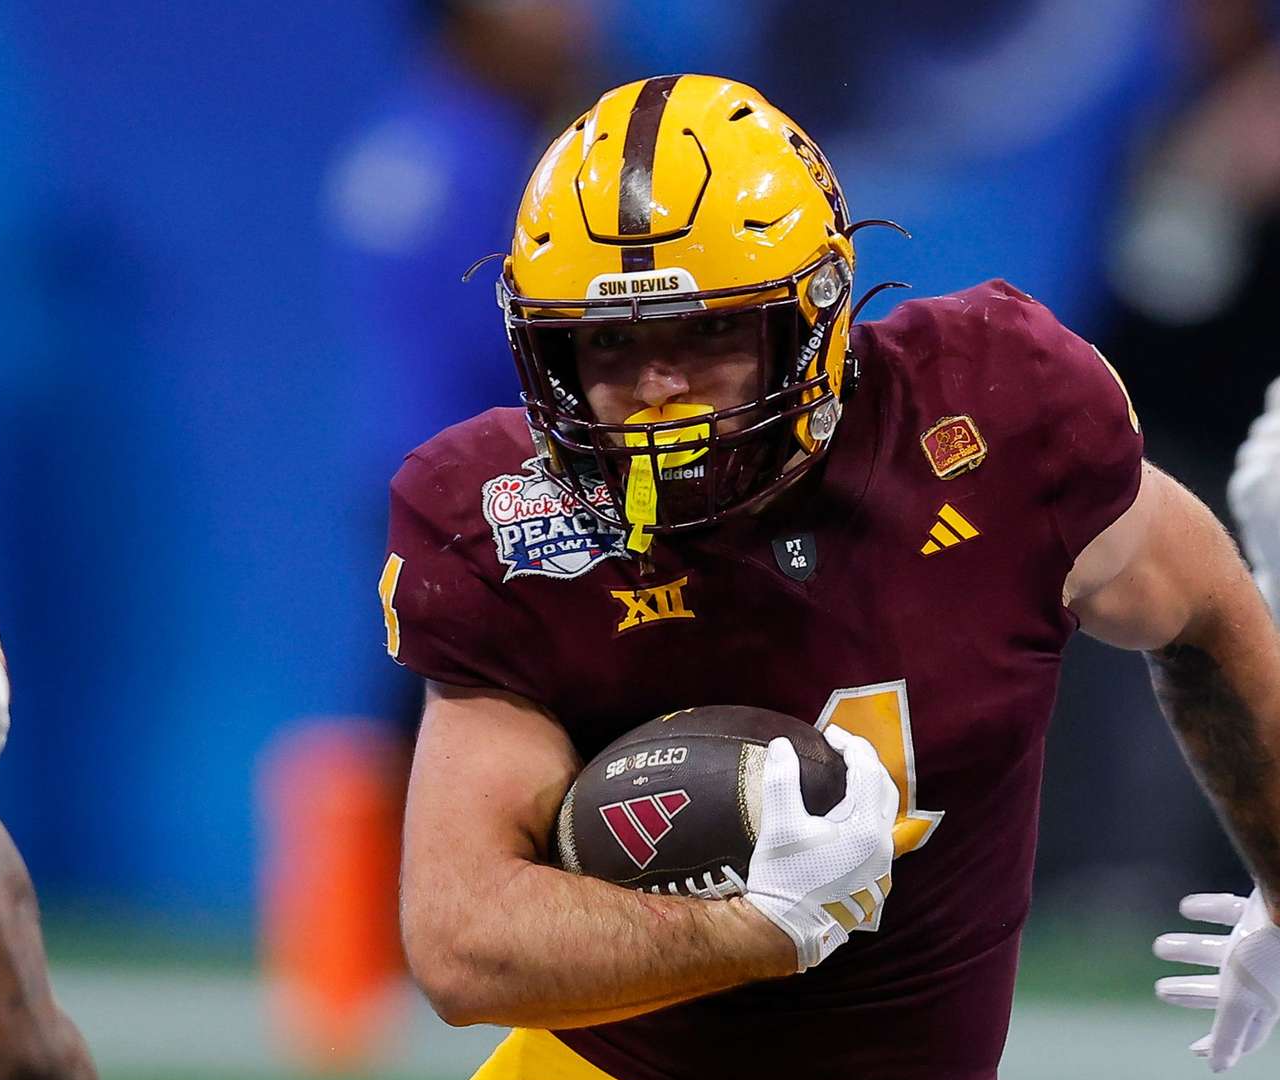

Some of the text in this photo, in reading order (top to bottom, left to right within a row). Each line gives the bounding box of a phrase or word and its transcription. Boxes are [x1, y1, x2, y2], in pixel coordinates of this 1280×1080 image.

[599, 276, 679, 296] SUN DEVILS
[528, 538, 600, 560] BOWL
[786, 539, 802, 553] PT
[790, 555, 807, 569] 42
[610, 576, 695, 632] XII
